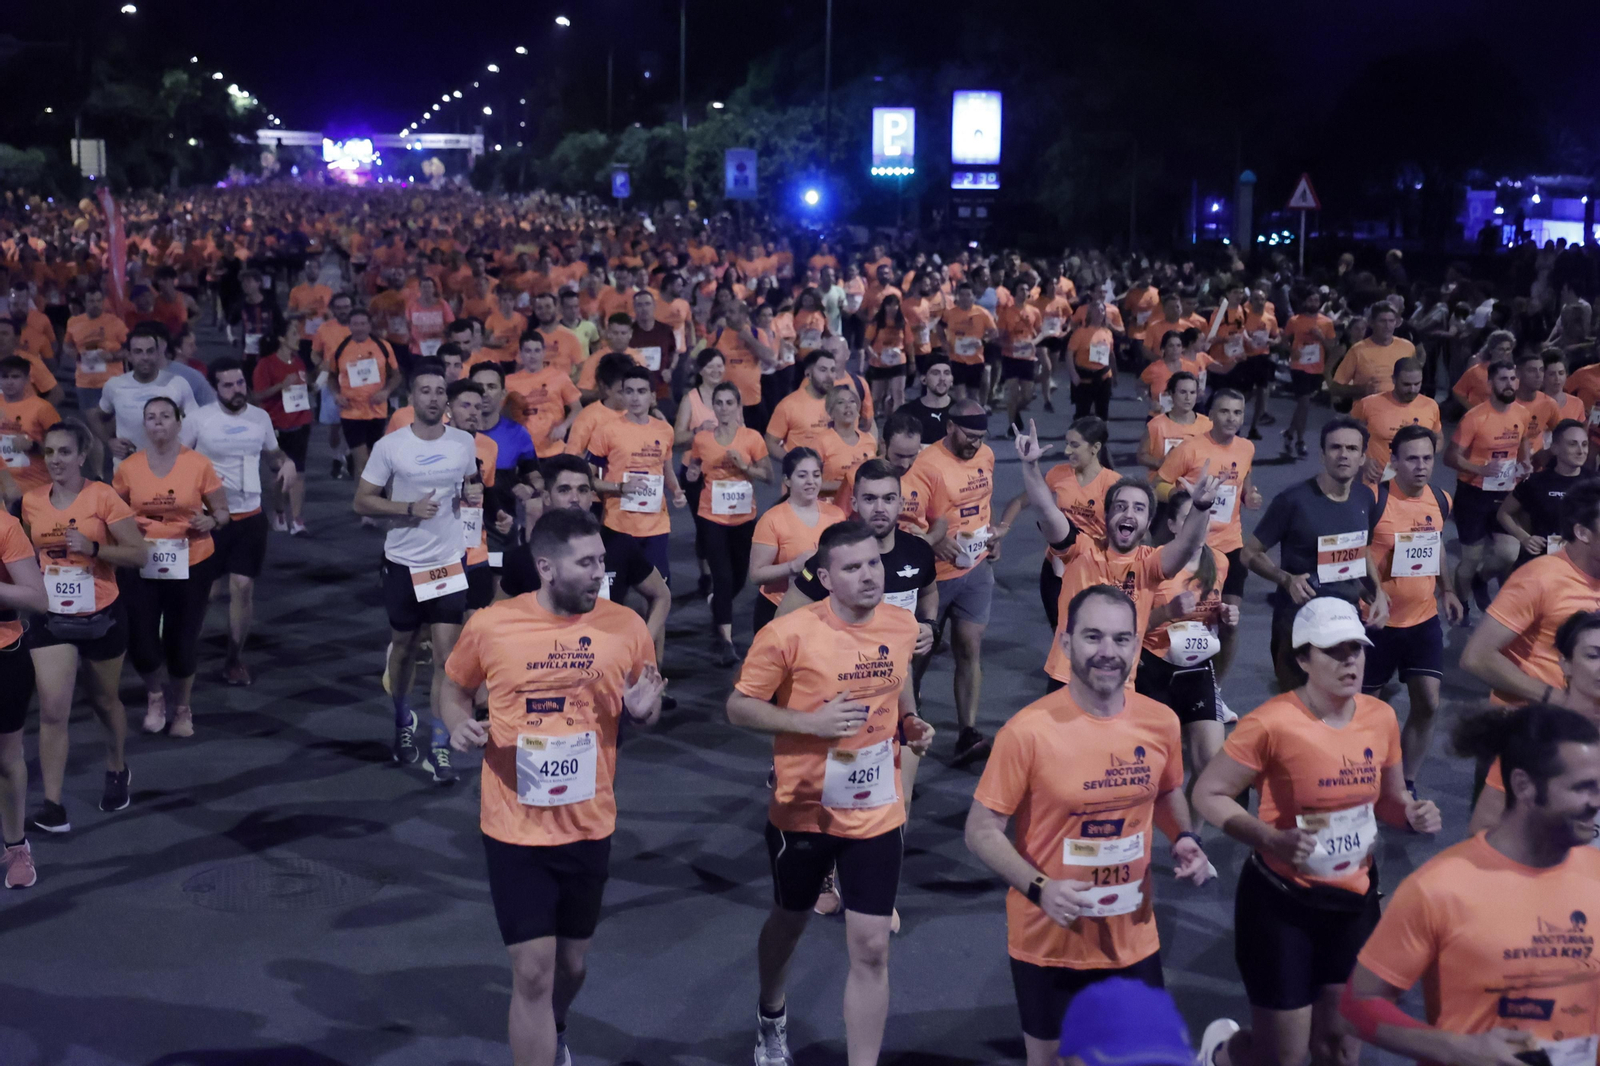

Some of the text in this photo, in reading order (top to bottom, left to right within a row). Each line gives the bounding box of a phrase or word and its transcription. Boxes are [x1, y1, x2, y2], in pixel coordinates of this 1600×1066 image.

[883, 112, 908, 149] P
[152, 552, 177, 562] 6079
[1331, 548, 1359, 563] 17267
[1406, 547, 1433, 558] 12053
[429, 567, 448, 580] 829
[56, 582, 81, 594] 6251
[1185, 638, 1209, 650] 3783
[547, 652, 595, 660] NOCTURNA
[526, 660, 593, 670] SEVILLA KH7
[855, 661, 894, 670] NOCTURNA
[837, 668, 893, 681] SEVILLA KH7
[539, 758, 579, 777] 4260
[1105, 766, 1151, 776] NOCTURNA
[848, 765, 880, 784] 4261
[1083, 774, 1151, 790] SEVILLA KH7
[1318, 777, 1358, 787] SEVILLA
[1326, 832, 1361, 856] 3784
[1092, 864, 1130, 886] 1213
[1531, 935, 1594, 945] NOCTURNA
[1503, 946, 1593, 960] SEVILLA KH7
